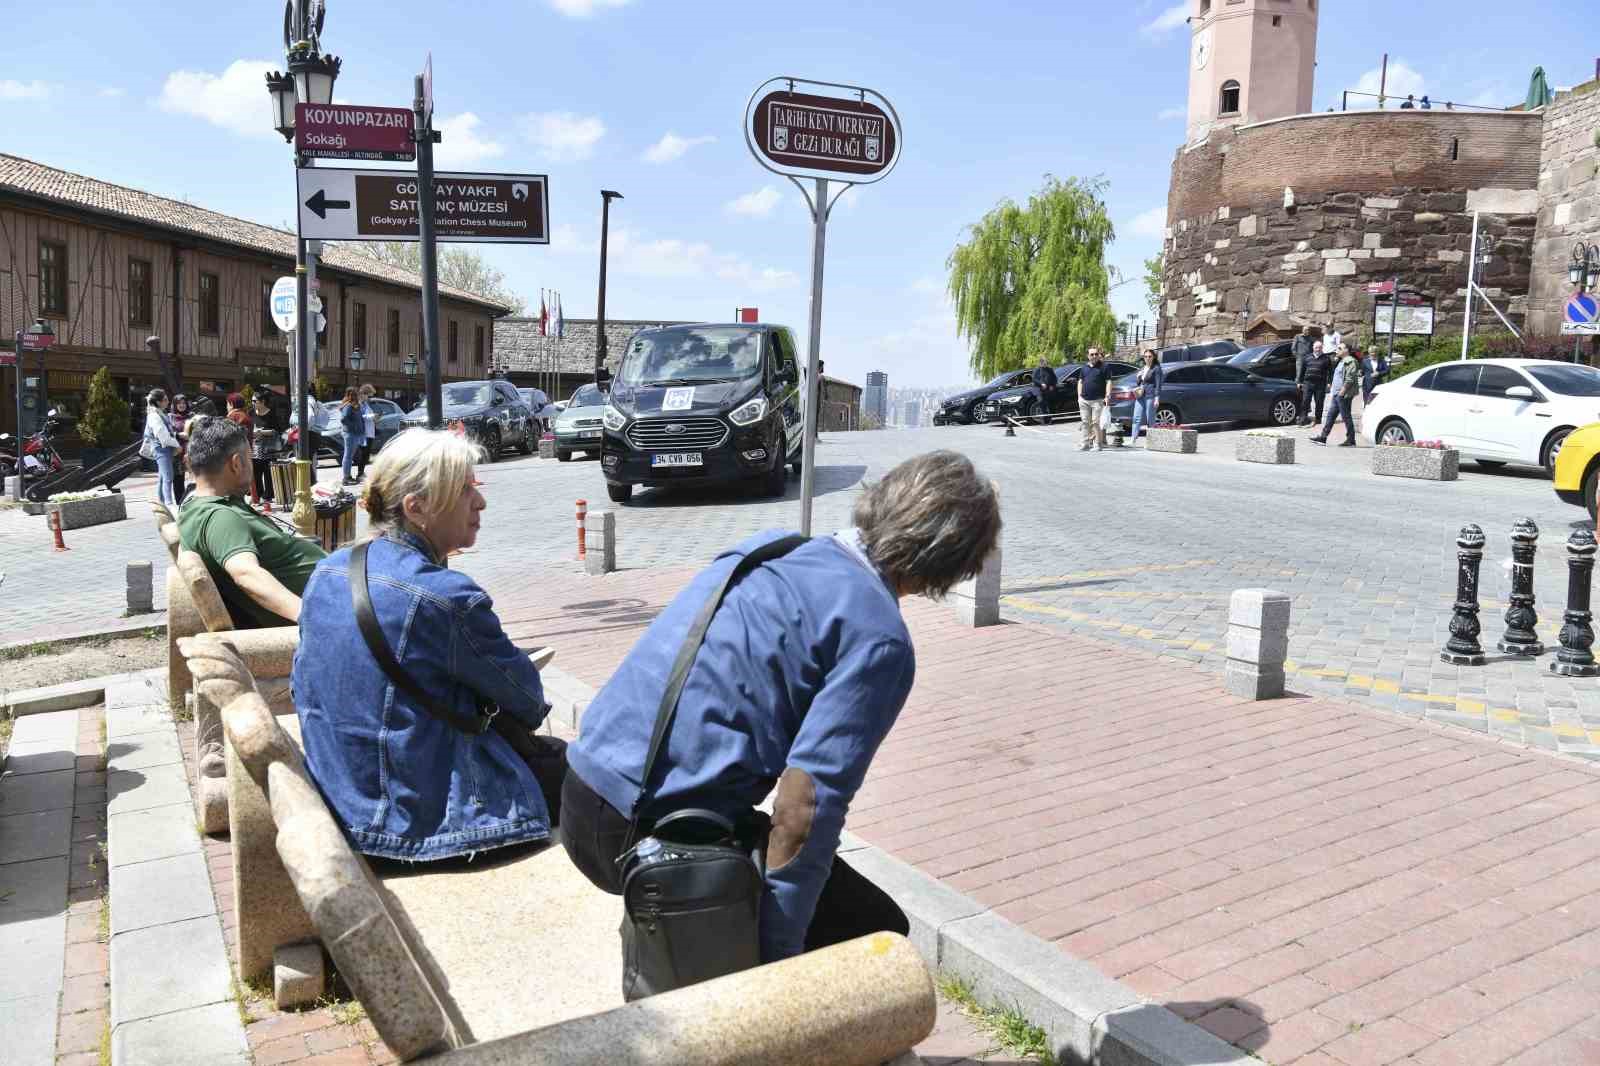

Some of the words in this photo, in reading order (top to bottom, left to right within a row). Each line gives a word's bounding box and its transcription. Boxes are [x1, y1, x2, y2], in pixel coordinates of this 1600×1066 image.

[304, 108, 408, 128] KOYUNPAZARI
[808, 112, 835, 132] KENT
[305, 132, 346, 149] Sokağı
[821, 136, 860, 157] DURAĞI
[396, 182, 455, 197] GÖAY
[457, 185, 497, 197] VAKFI
[389, 199, 456, 214] SATNÇ
[459, 200, 508, 214] MÜZESİ
[371, 216, 407, 227] (Gokyay
[409, 217, 458, 227] Foation
[460, 218, 487, 227] Chess
[488, 219, 527, 229] Museum)
[656, 455, 666, 464] 34
